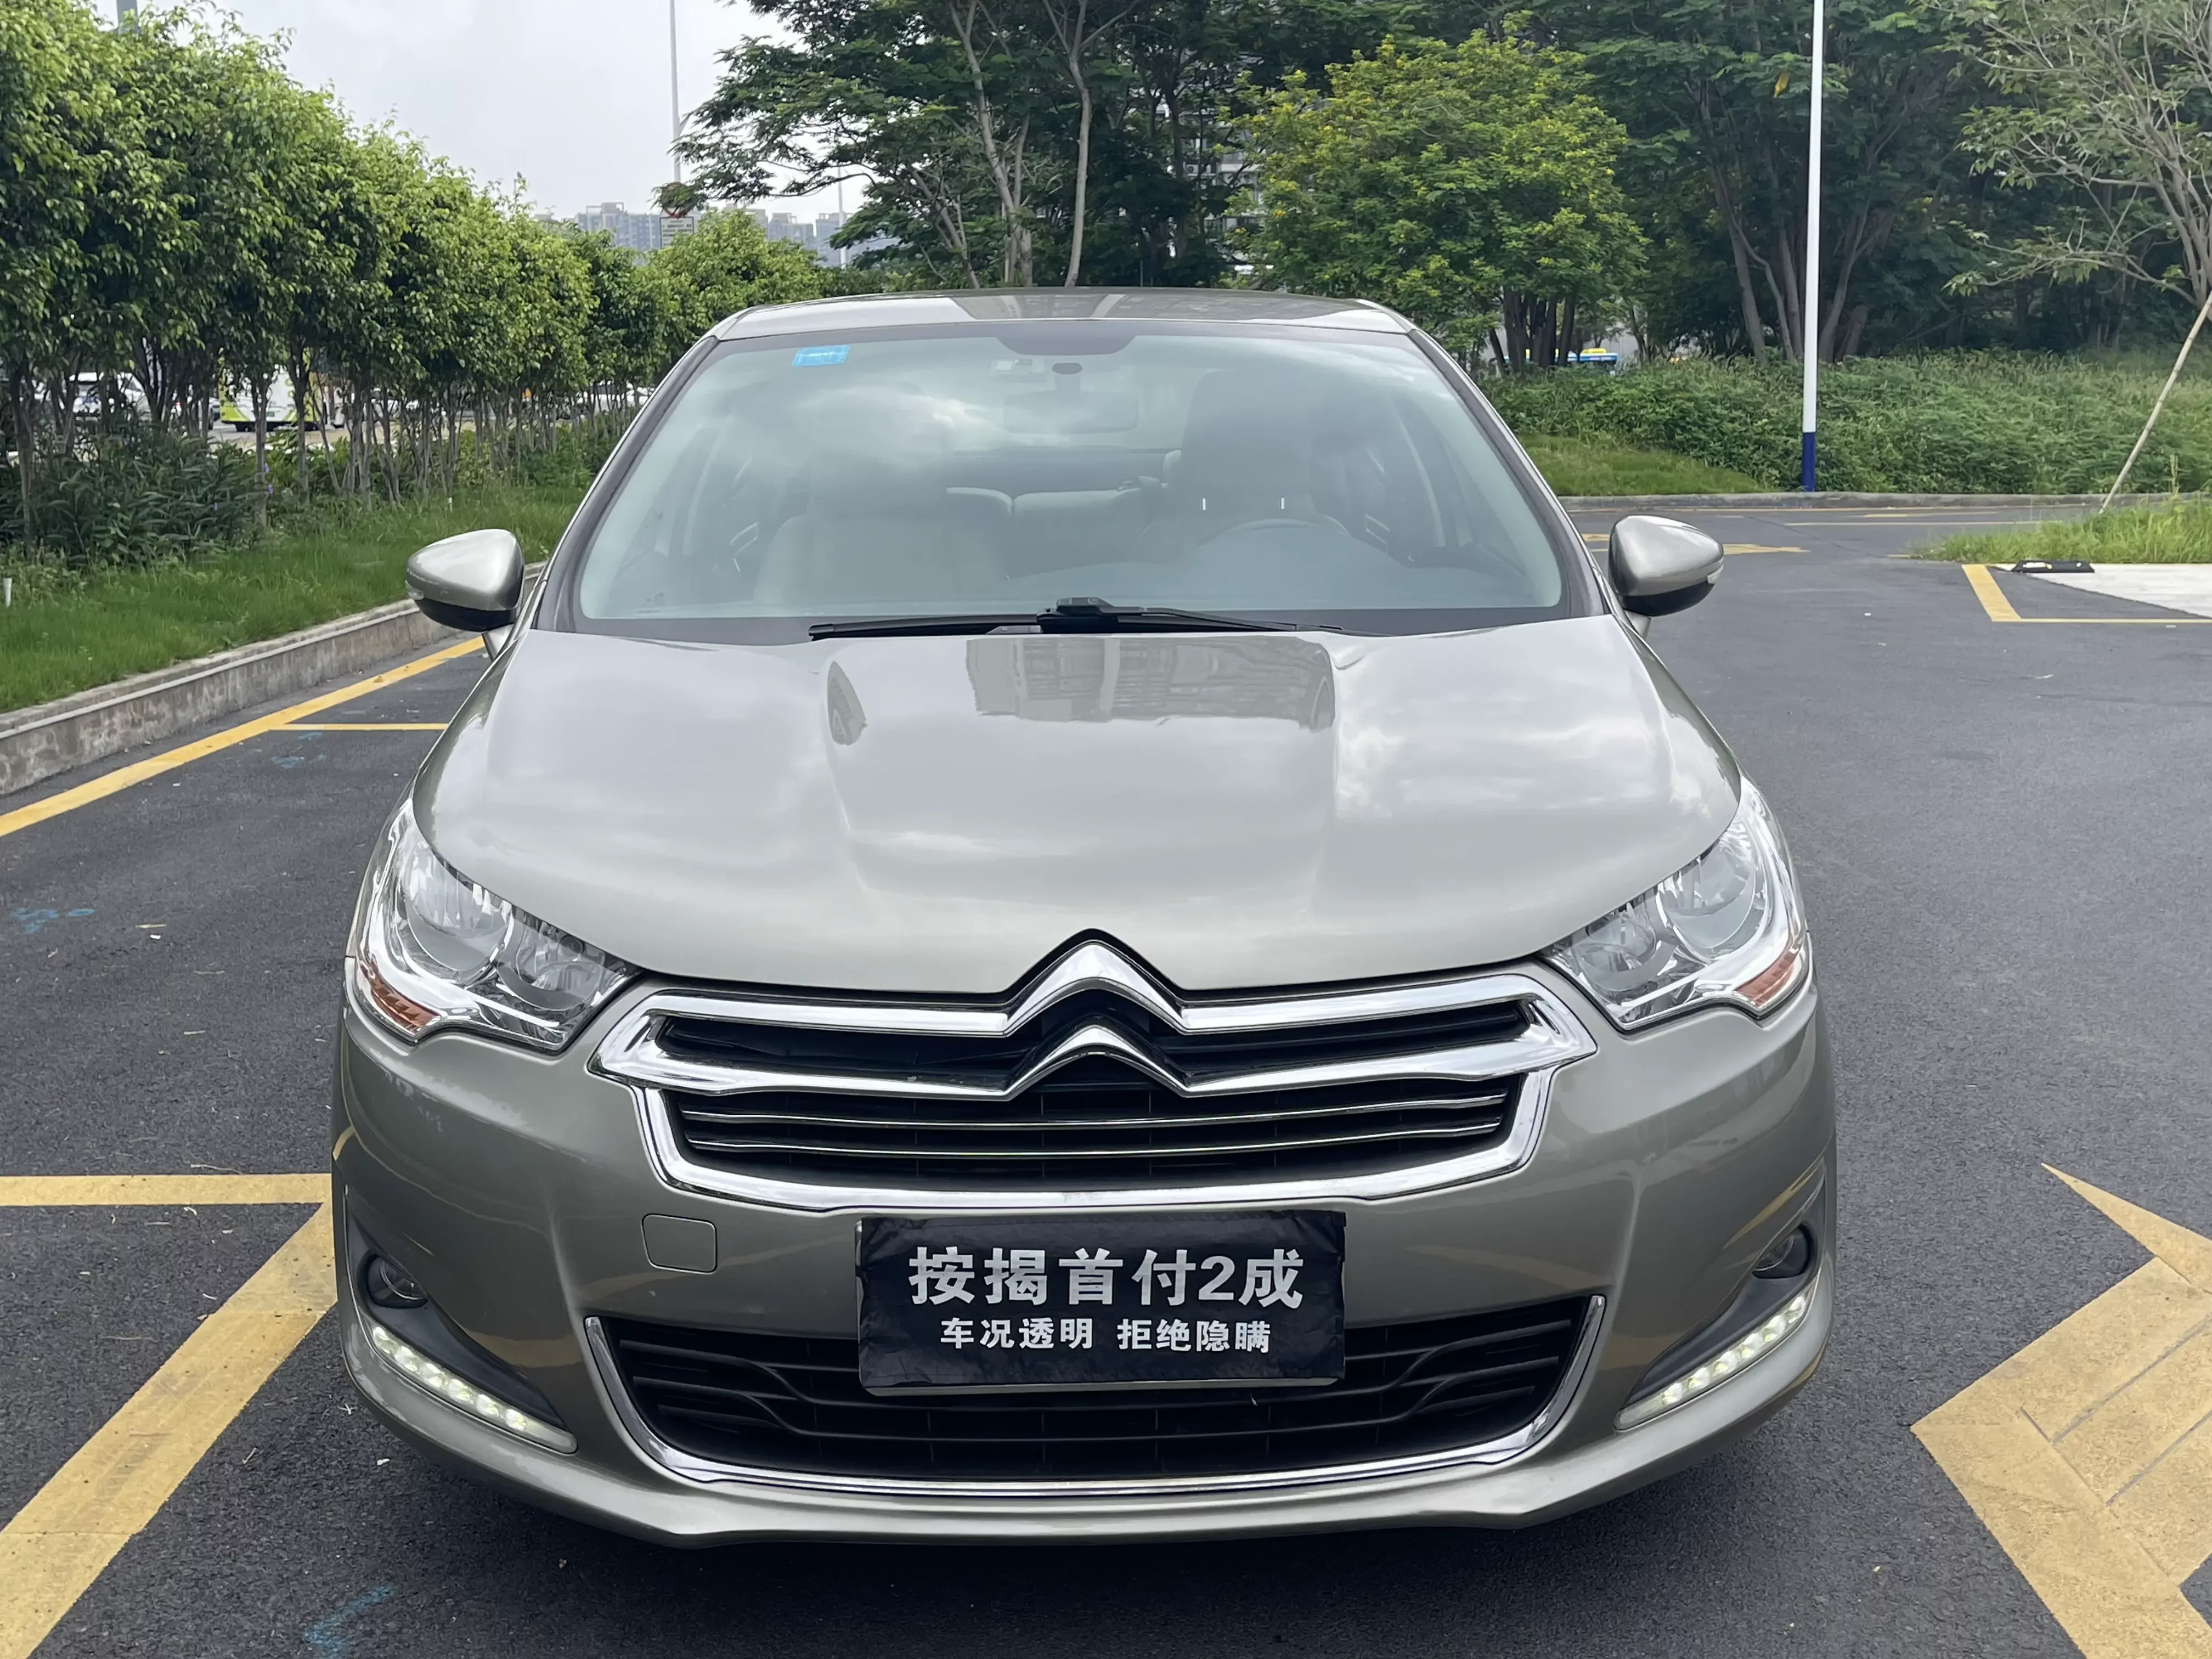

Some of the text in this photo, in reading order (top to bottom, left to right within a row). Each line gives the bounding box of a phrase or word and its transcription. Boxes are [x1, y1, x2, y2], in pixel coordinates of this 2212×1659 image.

[909, 1246, 1304, 1308] 按揭首付2成
[940, 1317, 1271, 1353] 车况透明 拒绝隐瞒
